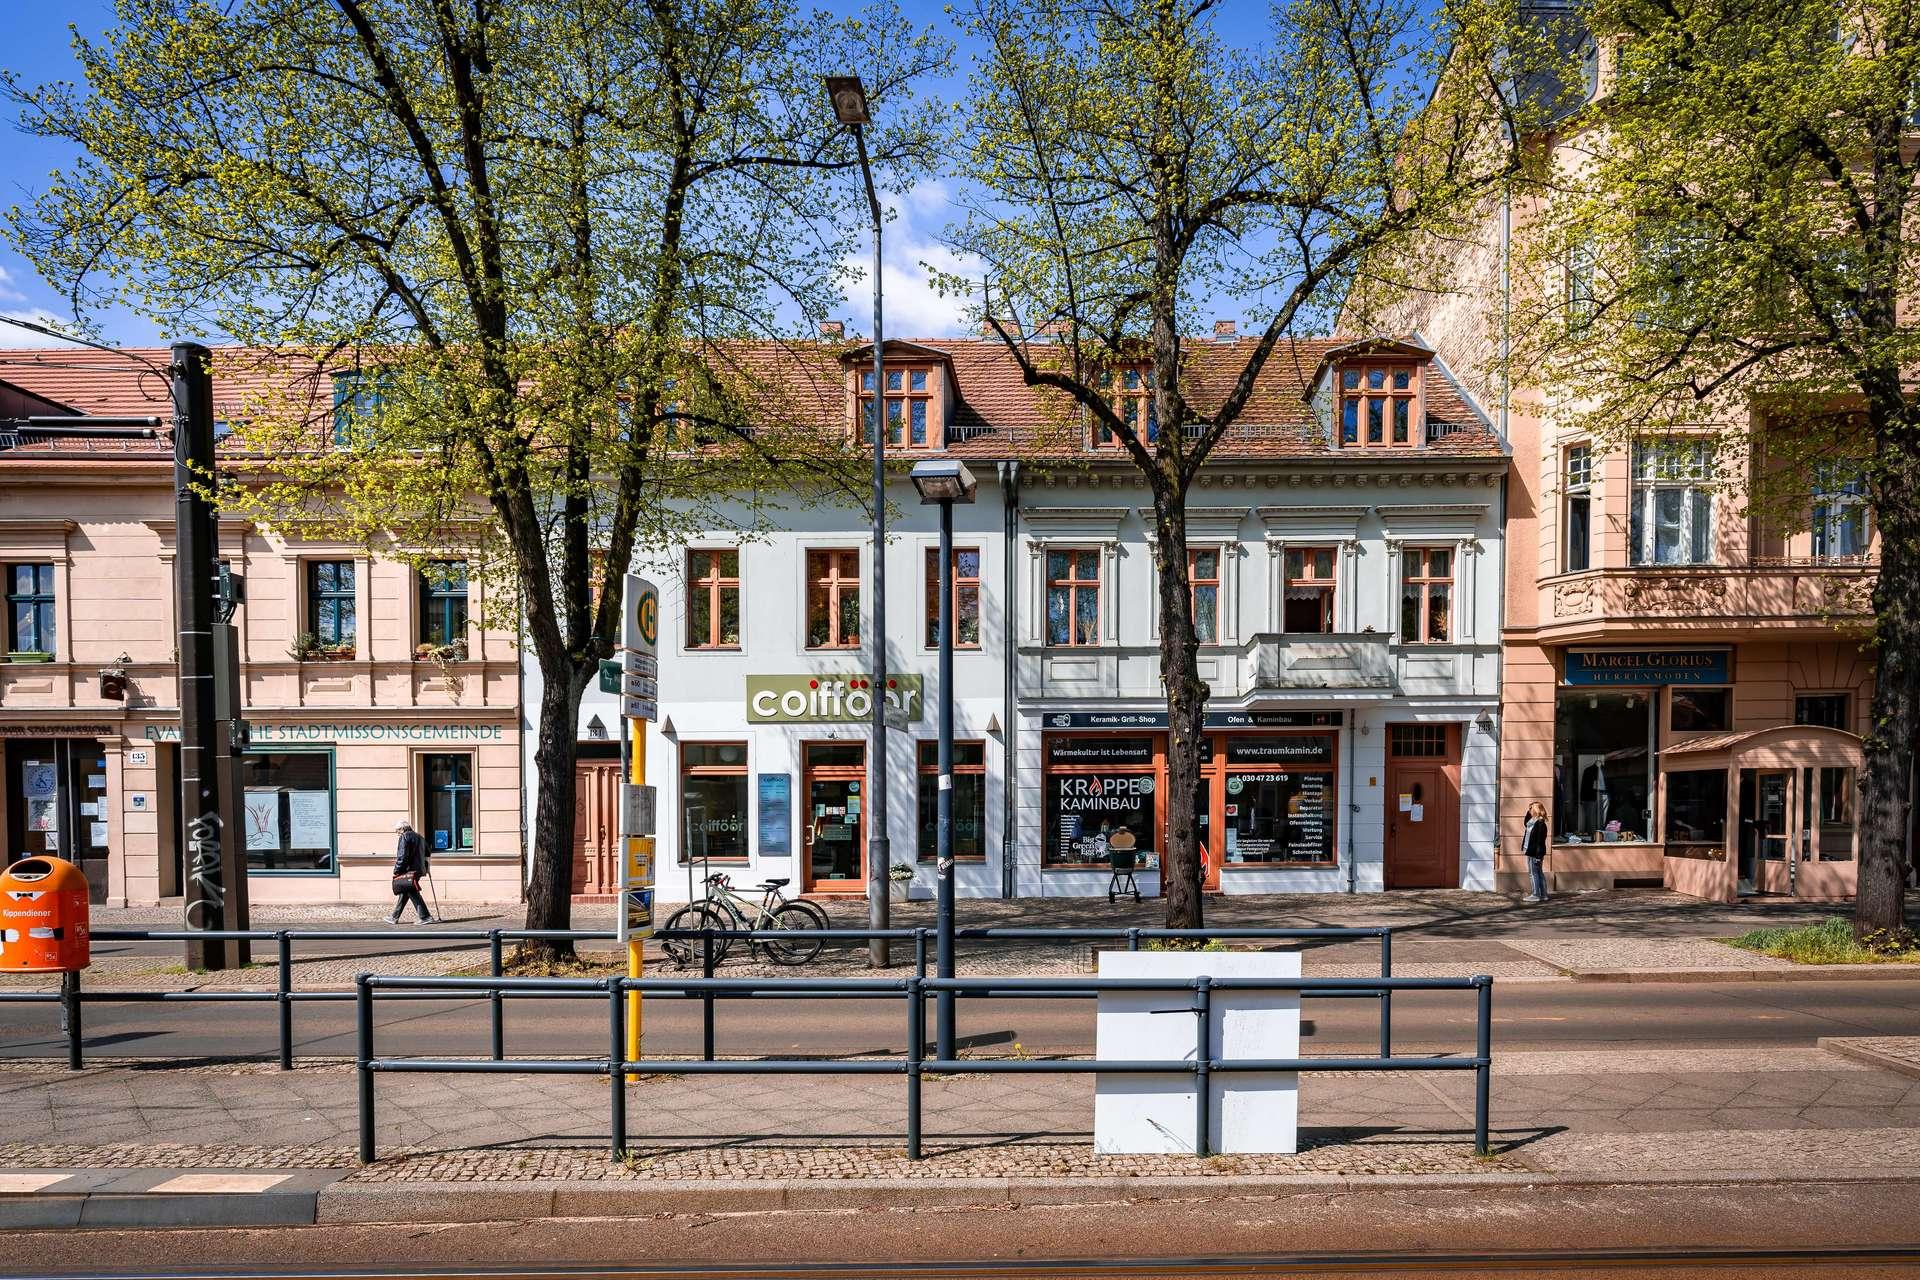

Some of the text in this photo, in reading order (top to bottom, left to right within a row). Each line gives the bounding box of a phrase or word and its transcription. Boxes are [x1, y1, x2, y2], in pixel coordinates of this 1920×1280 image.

[1138, 715, 1156, 724] Shop
[1053, 748, 1148, 756] Wärmekultur ist Lebensart
[1236, 746, 1323, 756] www.traumkamin.de
[1242, 774, 1255, 782] 030
[1256, 774, 1265, 782] 47
[1266, 774, 1275, 782] 23
[1060, 797, 1140, 810] KAMINBAU
[1082, 836, 1095, 844] Big
[1072, 842, 1095, 850] Green
[3, 908, 52, 918] Kippendiener
